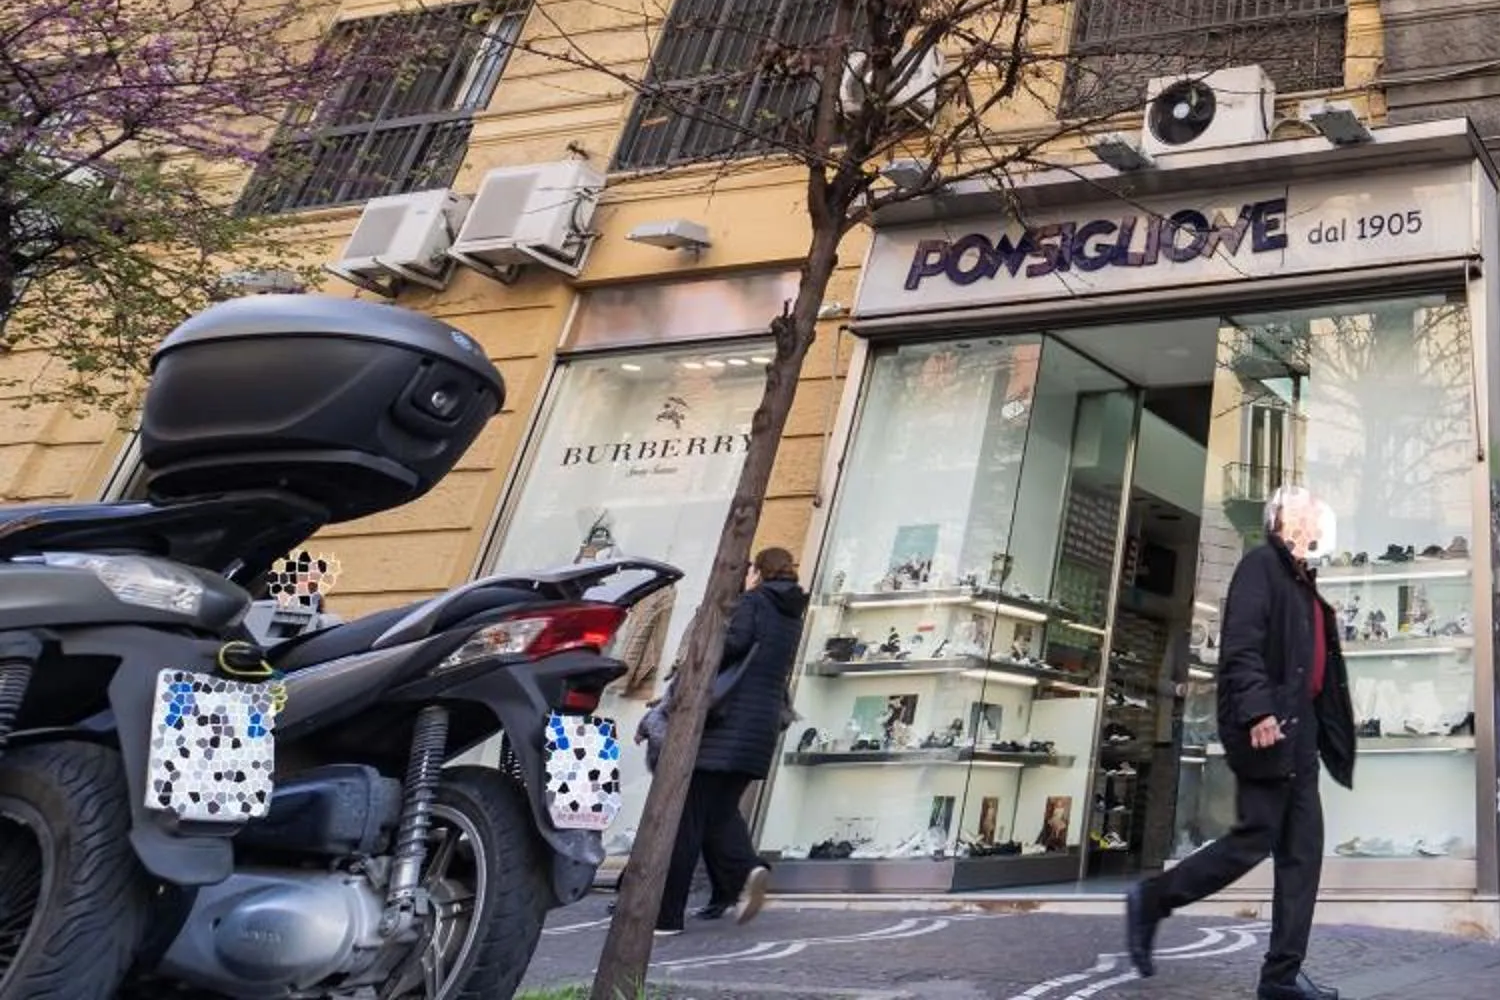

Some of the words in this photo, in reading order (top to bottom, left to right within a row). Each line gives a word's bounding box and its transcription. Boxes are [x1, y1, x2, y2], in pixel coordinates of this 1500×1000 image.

[904, 198, 1288, 290] PONSIGLIONE
[1308, 217, 1346, 245] dal
[1357, 210, 1423, 241] 1905
